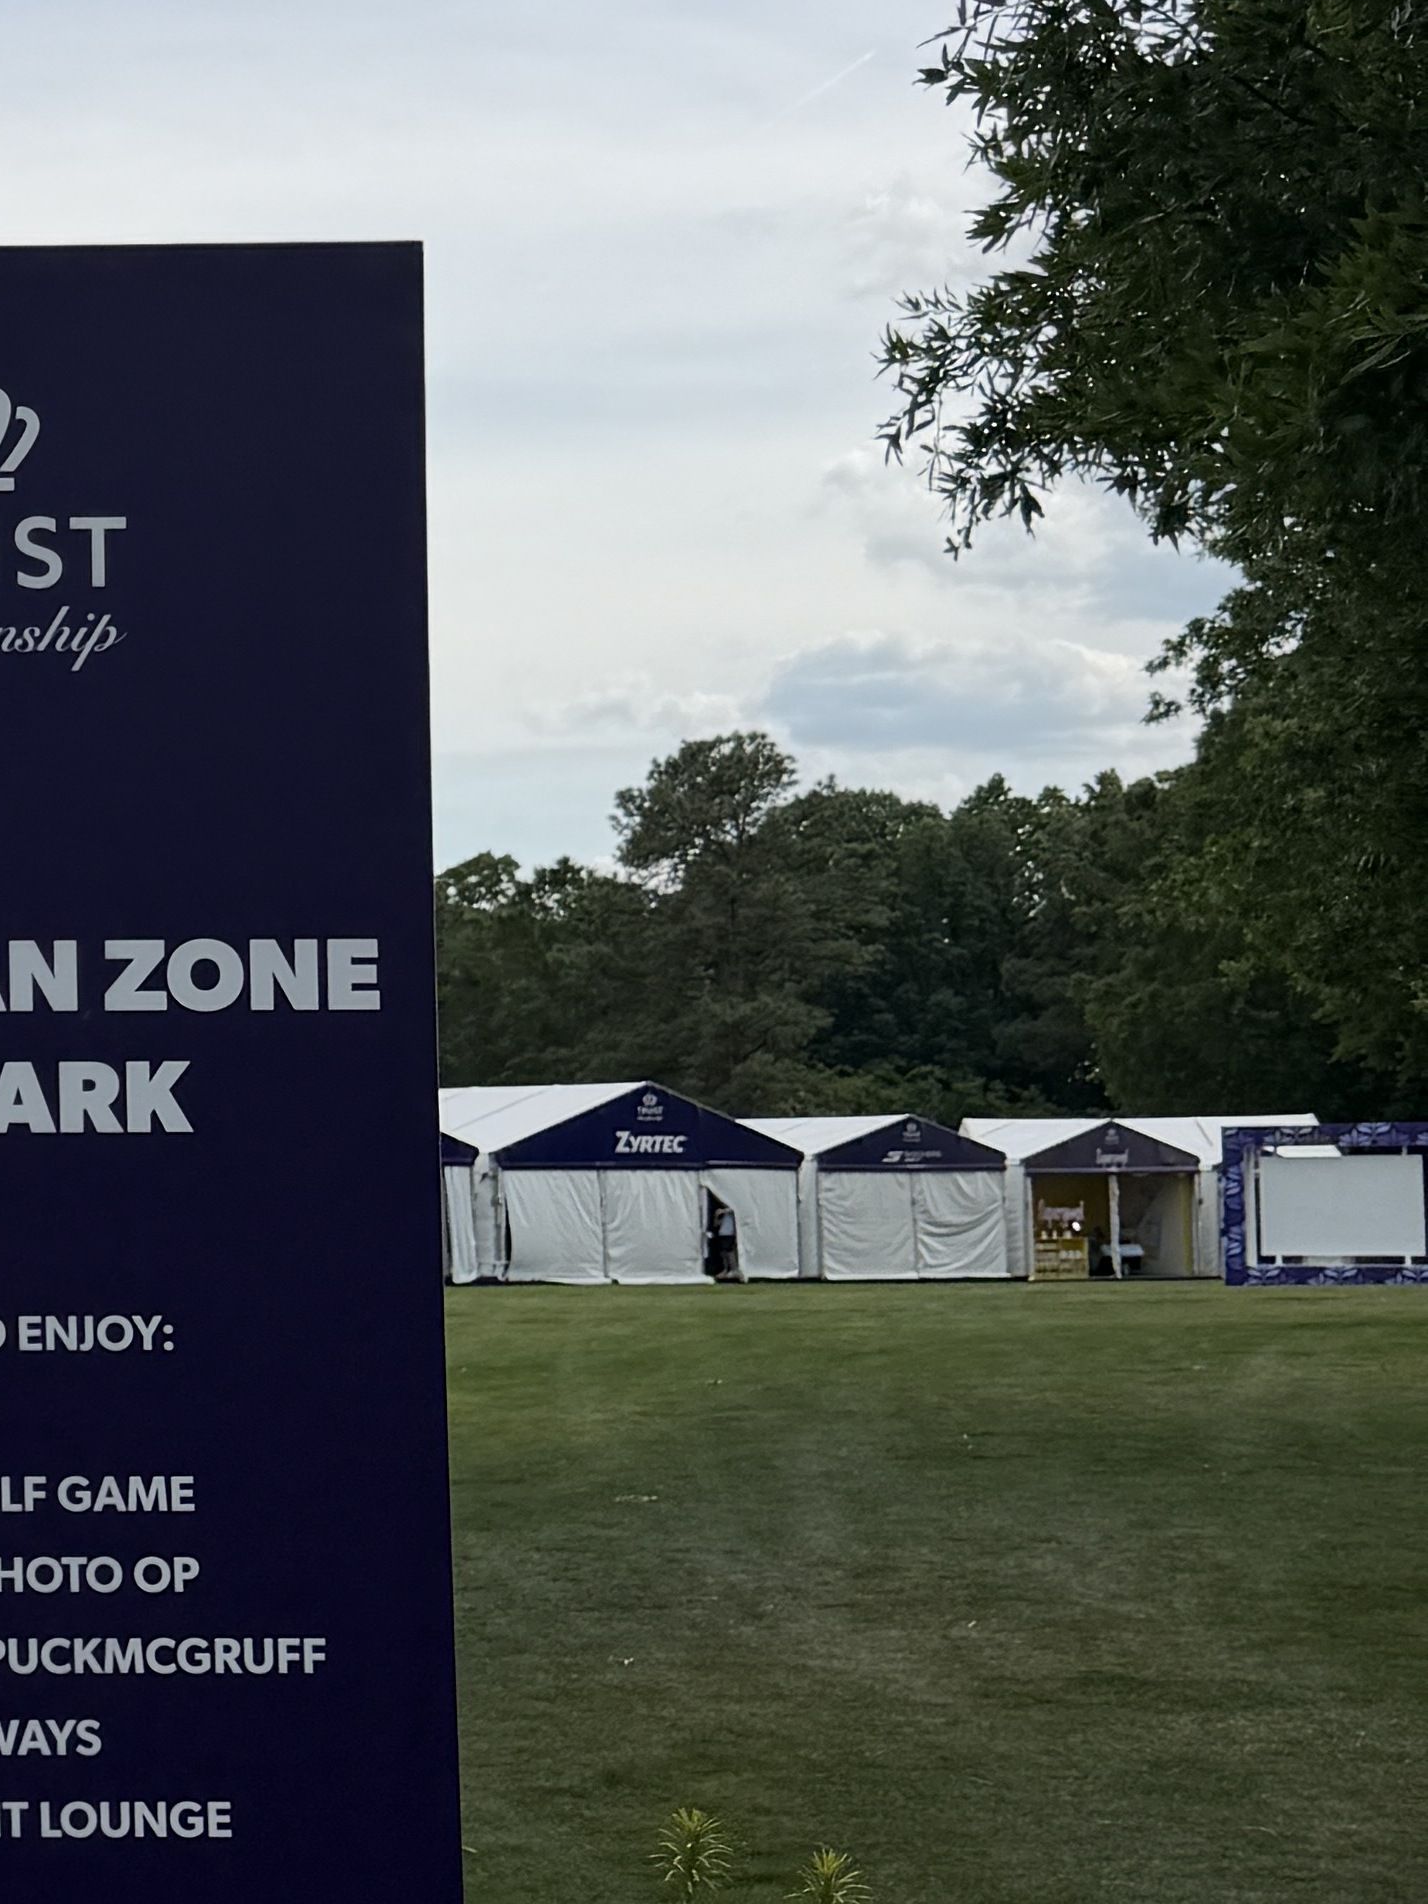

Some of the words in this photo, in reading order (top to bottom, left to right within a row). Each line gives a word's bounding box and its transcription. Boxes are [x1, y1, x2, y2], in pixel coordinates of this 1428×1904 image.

[104, 938, 381, 1012] ZONE
[614, 1130, 687, 1154] ZYRTEC
[18, 1314, 174, 1352] ENJOY:
[57, 1475, 196, 1513] GAME
[133, 1556, 200, 1593] OP
[39, 1800, 233, 1839] LOUNGE
